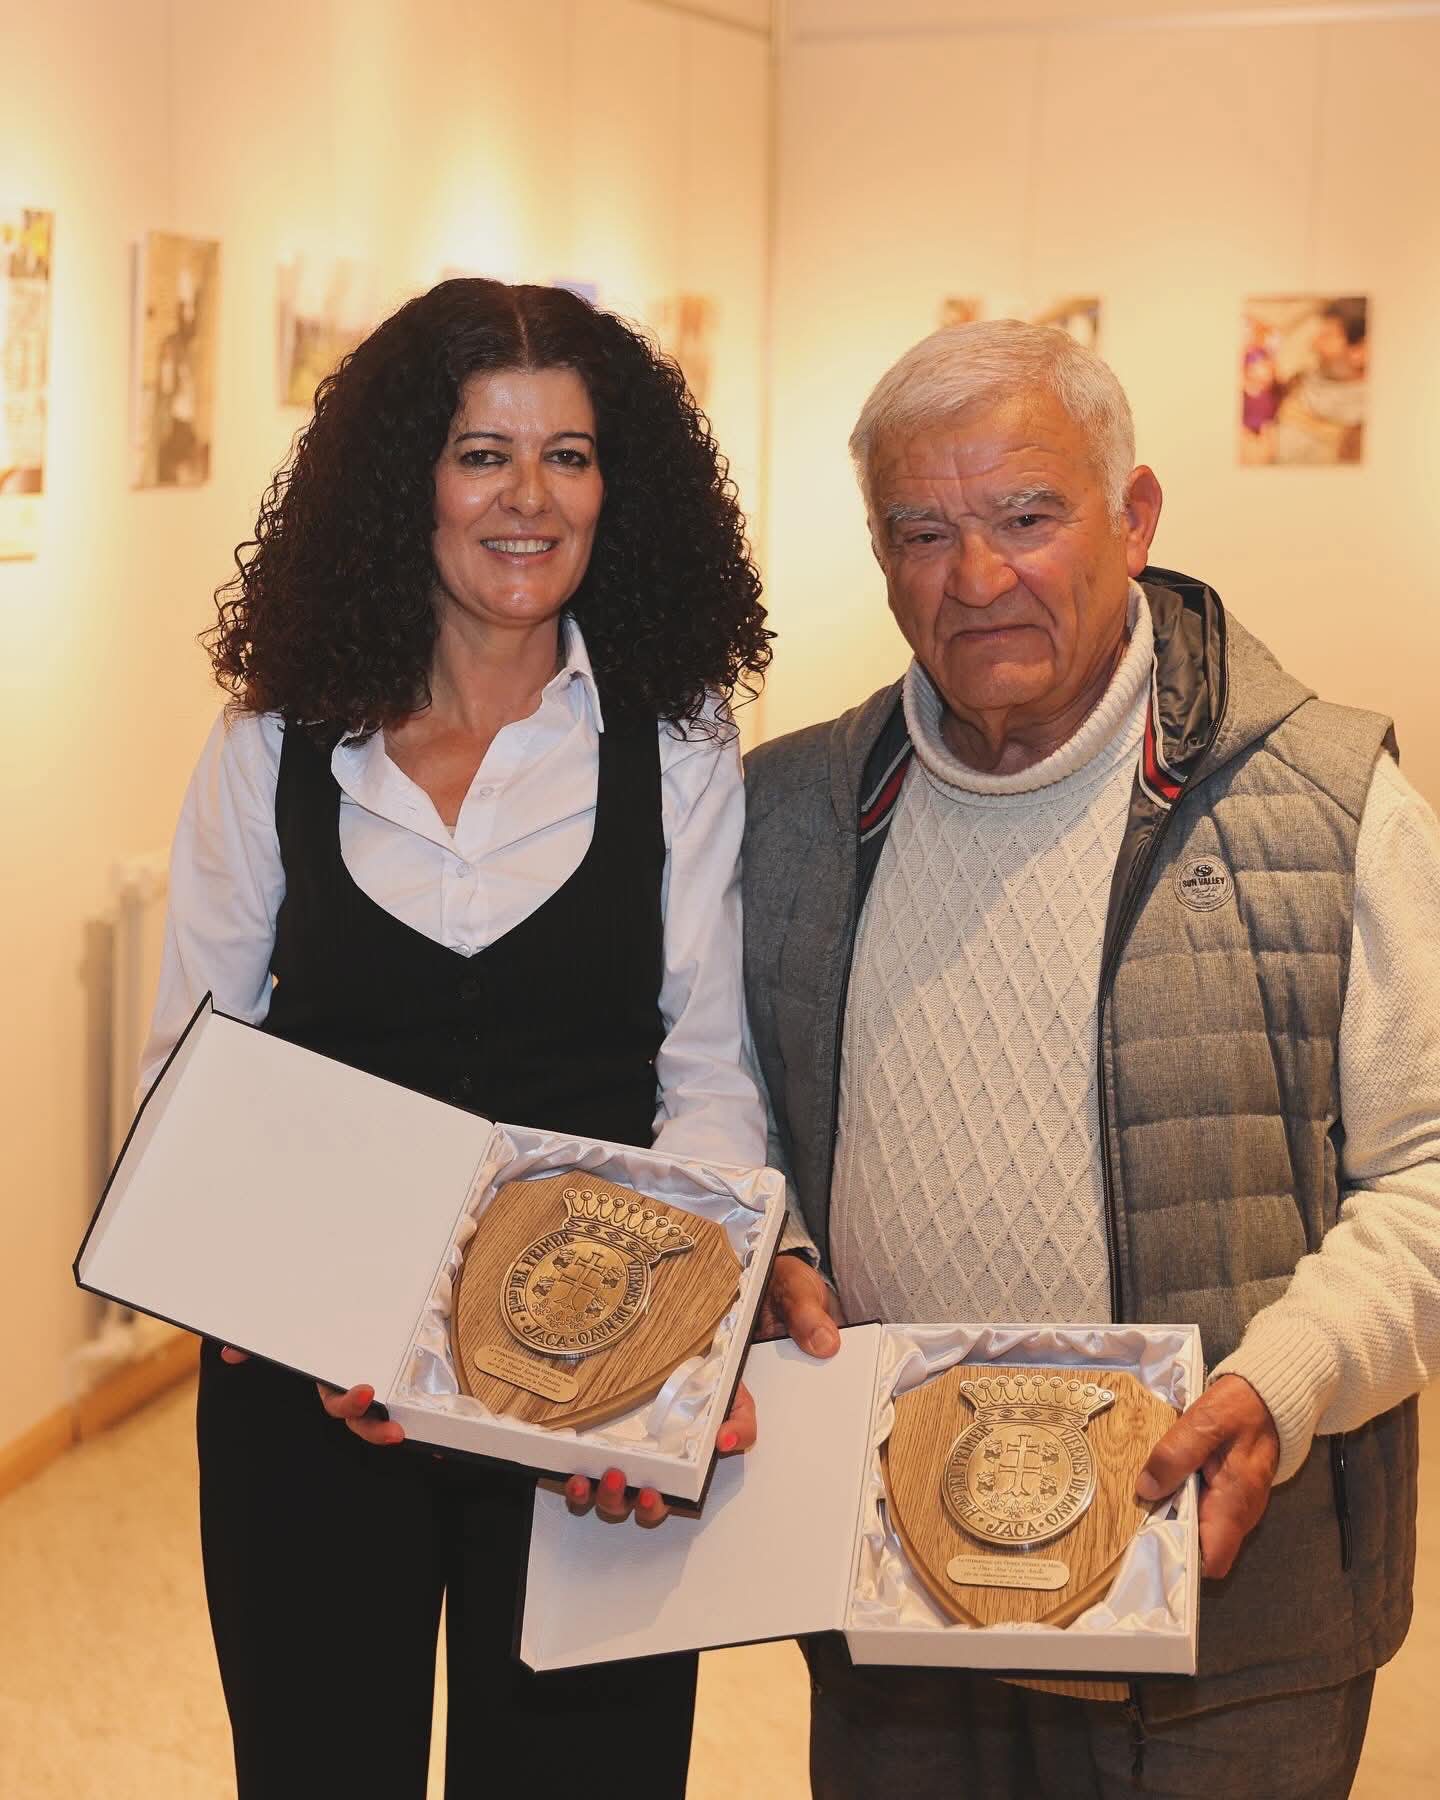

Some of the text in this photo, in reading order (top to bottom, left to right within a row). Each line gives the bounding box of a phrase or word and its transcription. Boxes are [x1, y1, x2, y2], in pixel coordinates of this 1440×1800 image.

[1182, 877, 1225, 888] SUN VALLEY
[522, 1233, 574, 1267] PRIMER
[511, 1269, 529, 1288] DEL
[623, 1260, 644, 1307] VIERNES
[610, 1306, 631, 1326] DE
[523, 1325, 567, 1347] JACA
[576, 1322, 617, 1345] MAYO
[952, 1424, 993, 1467] PRIMER
[1059, 1429, 1089, 1475] VIERNES
[950, 1472, 966, 1494] DEL
[1070, 1478, 1087, 1493] DE
[1045, 1492, 1081, 1525] MAYO
[986, 1521, 1040, 1537] JACA
